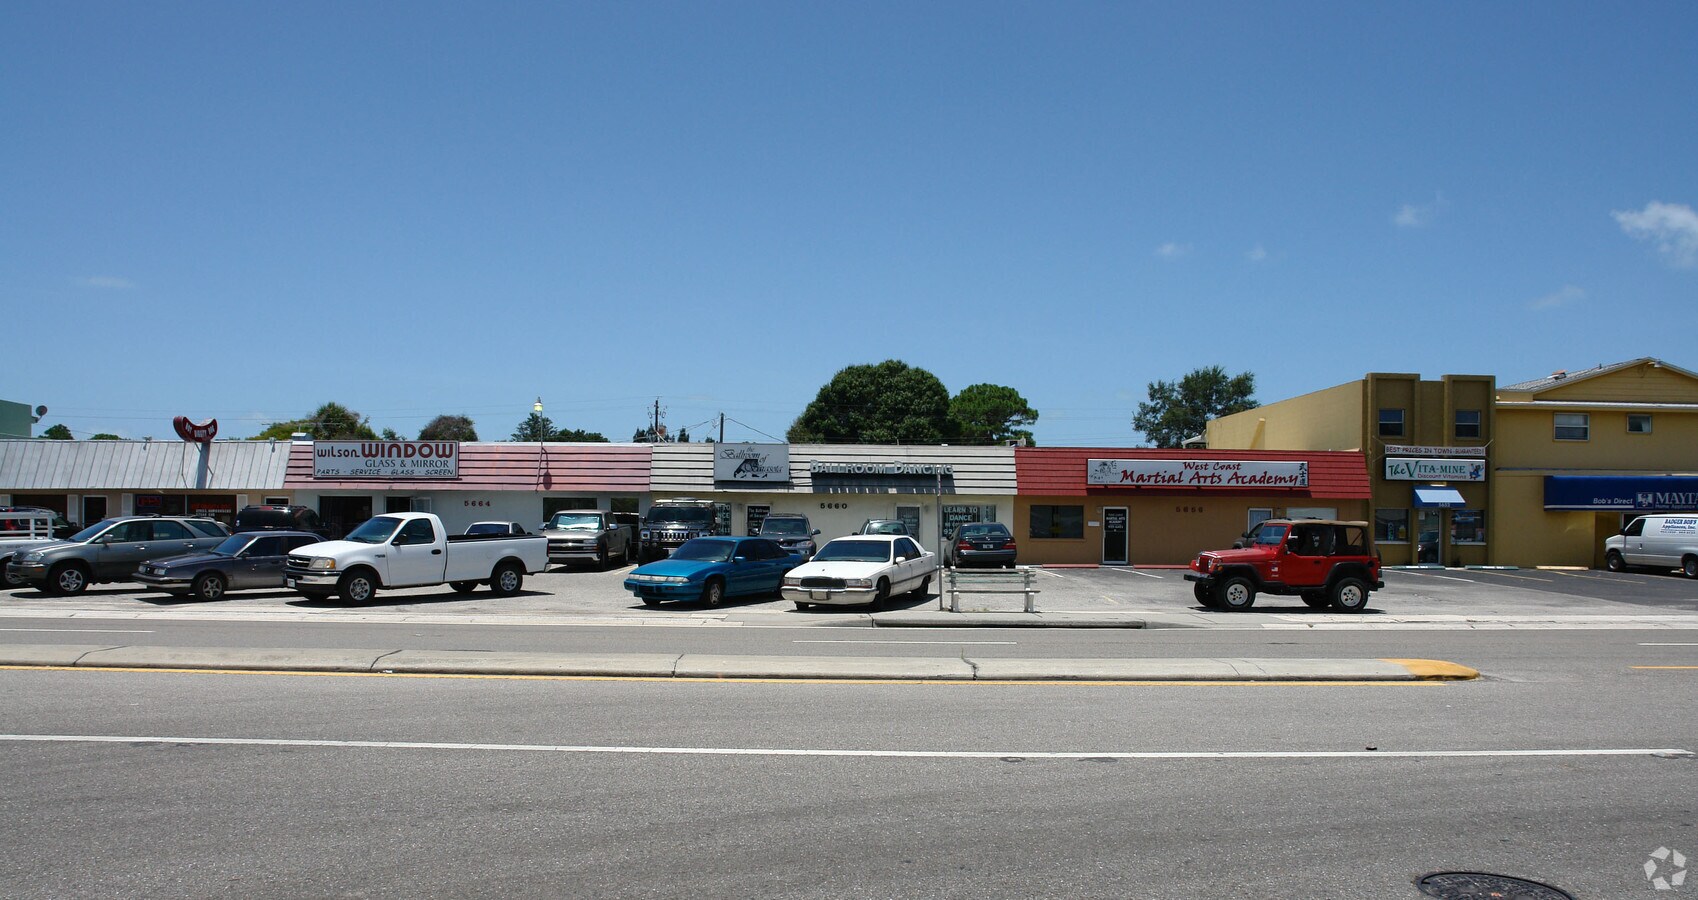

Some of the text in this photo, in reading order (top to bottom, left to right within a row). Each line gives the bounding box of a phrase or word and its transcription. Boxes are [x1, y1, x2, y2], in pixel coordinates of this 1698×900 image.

[361, 444, 454, 458] WINDOW
[719, 449, 761, 460] Ballroom
[1402, 446, 1423, 454] PRICES
[364, 459, 396, 468] GLASS
[410, 459, 449, 469] MIRROR
[810, 460, 886, 474] BALLROOM
[1183, 462, 1241, 470] West Coast
[1388, 463, 1407, 477] The
[1120, 470, 1298, 485] Martial Arts Academy
